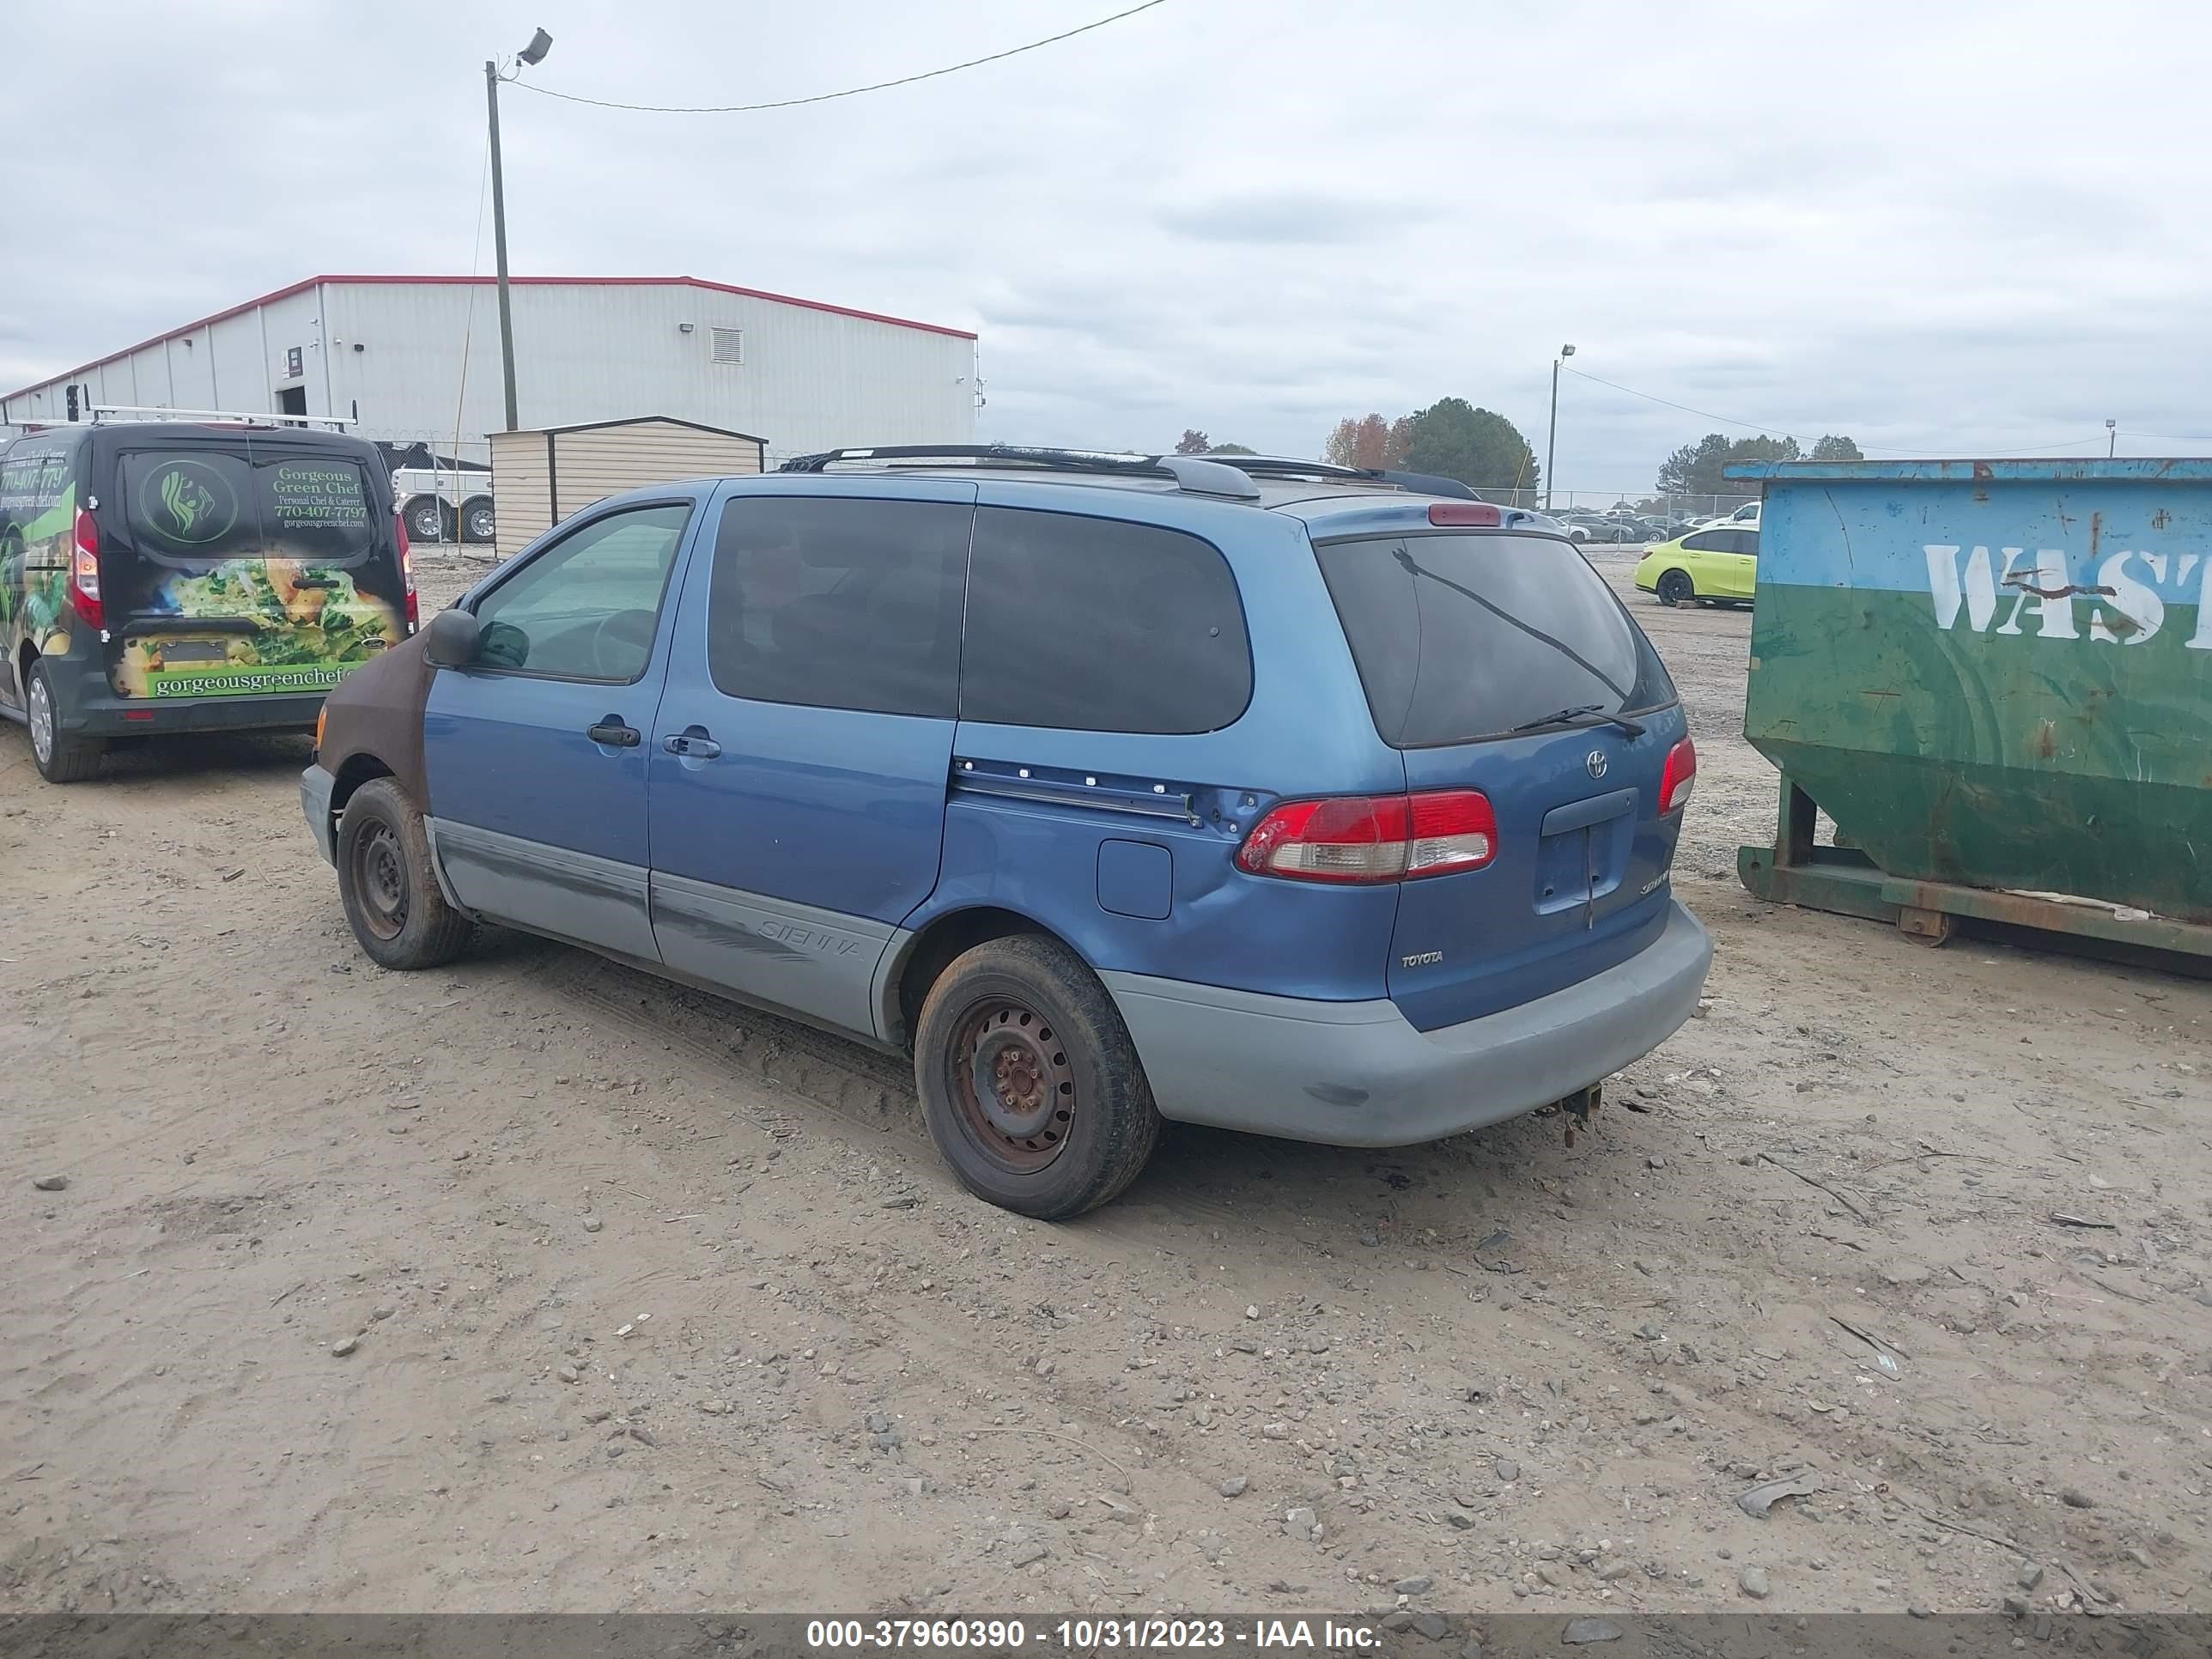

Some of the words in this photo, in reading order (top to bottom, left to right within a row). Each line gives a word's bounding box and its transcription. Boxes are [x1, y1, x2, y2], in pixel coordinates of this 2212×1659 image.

[278, 467, 352, 483] Gorgeous
[273, 481, 320, 494] Green
[325, 482, 359, 495] Chef
[278, 495, 309, 506] Personal
[310, 495, 327, 506] Chef
[328, 496, 335, 506] &
[336, 496, 361, 507] Caterer
[274, 506, 367, 518] 770-407-7797
[283, 519, 364, 529] gorgeousgreenchef.com
[756, 921, 866, 962] SIENNA
[1401, 951, 1443, 969] TOYOTA
